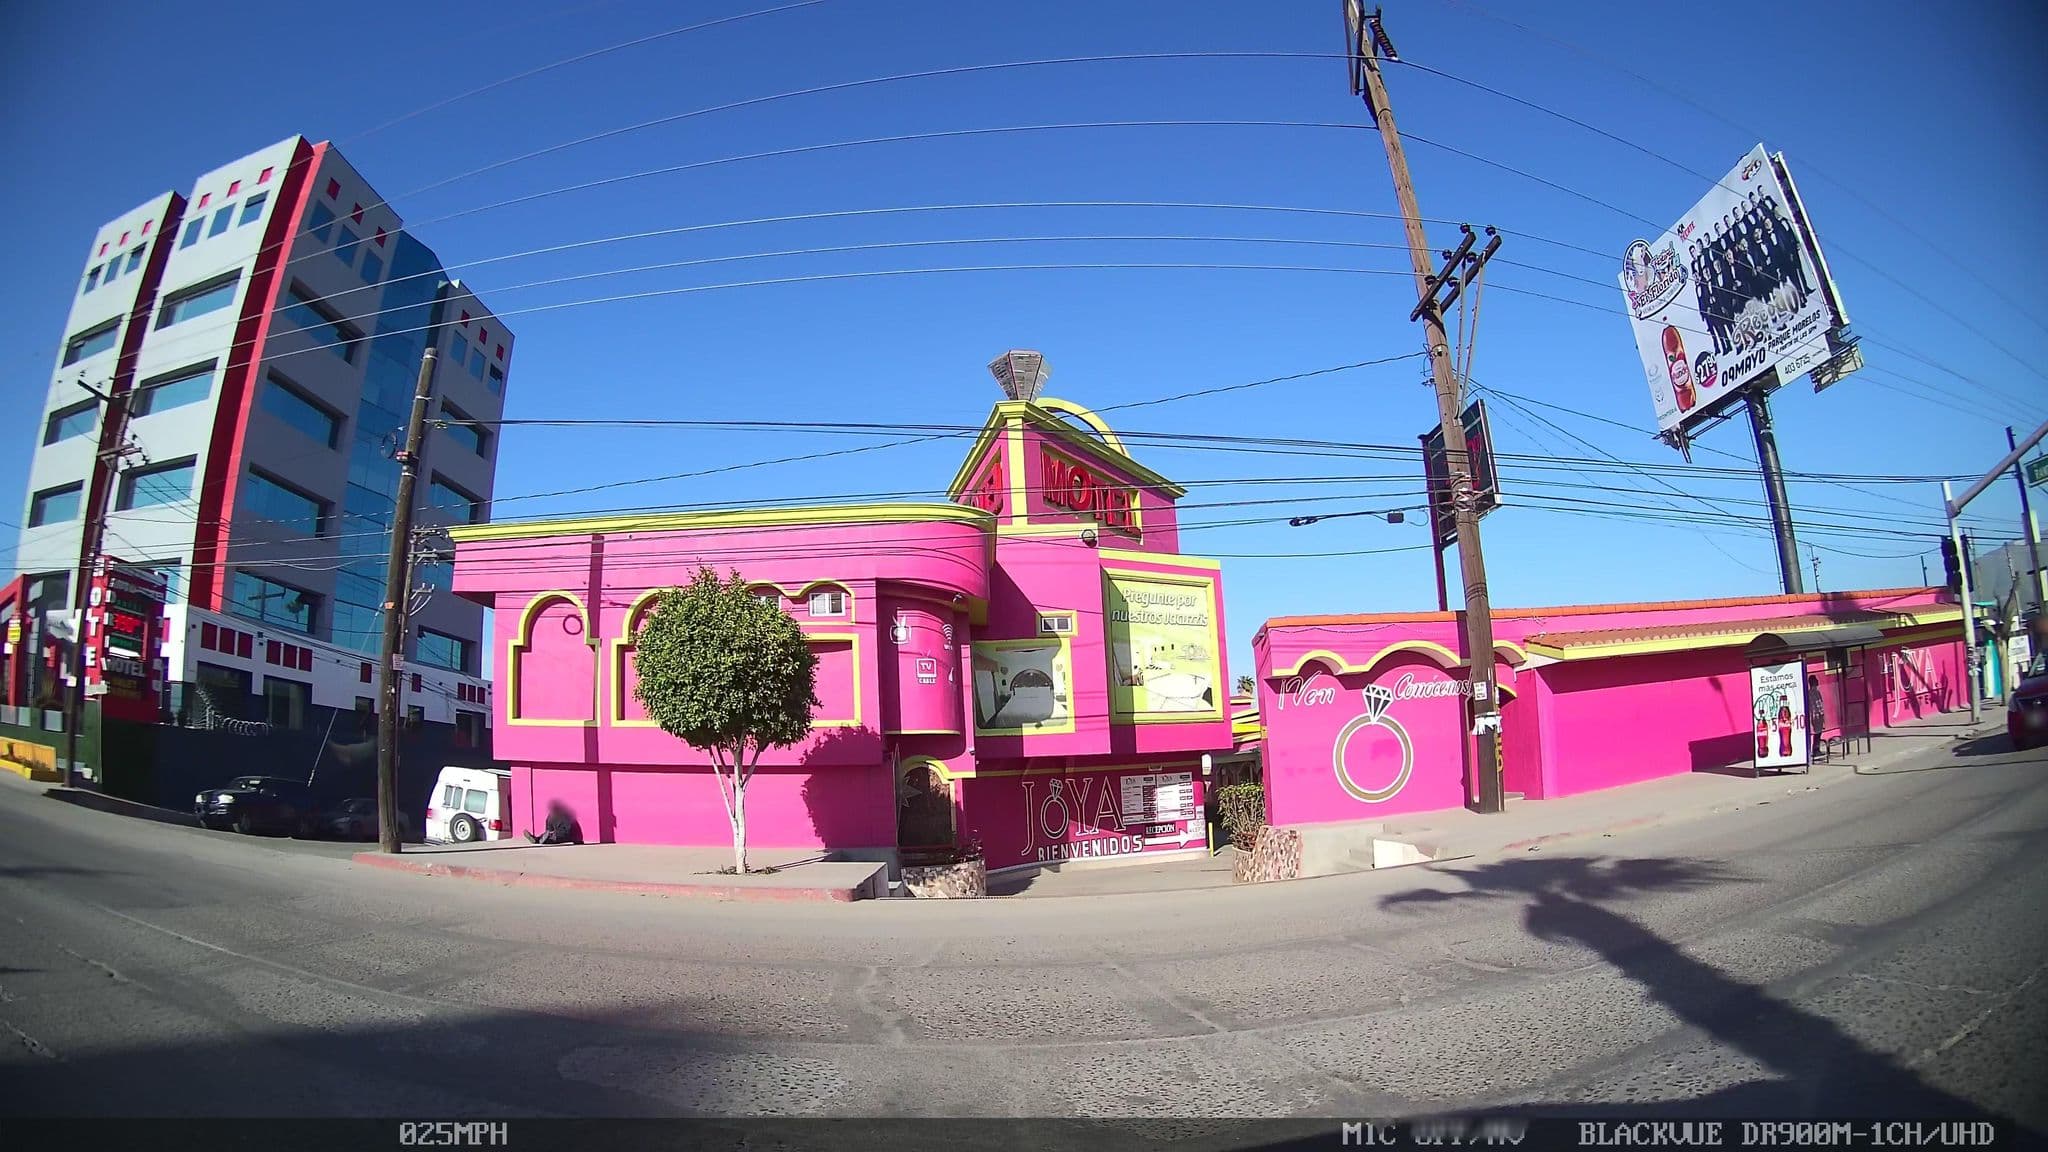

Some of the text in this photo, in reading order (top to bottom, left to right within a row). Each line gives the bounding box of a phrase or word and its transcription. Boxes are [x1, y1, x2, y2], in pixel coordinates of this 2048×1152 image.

[1767, 328, 1791, 351] PARQUE
[1792, 309, 1821, 336] MORELOS
[1041, 449, 1142, 537] MOTEL
[1122, 588, 1198, 610] Pregunte por
[1111, 608, 1163, 623] nuestros
[919, 662, 933, 671] TV
[1760, 673, 1794, 684] Estamos
[1278, 670, 1336, 710] ¡Ven
[1776, 681, 1798, 690] cerca
[1021, 776, 1126, 856] JOYA
[1038, 834, 1143, 861] BIENVENIDOS
